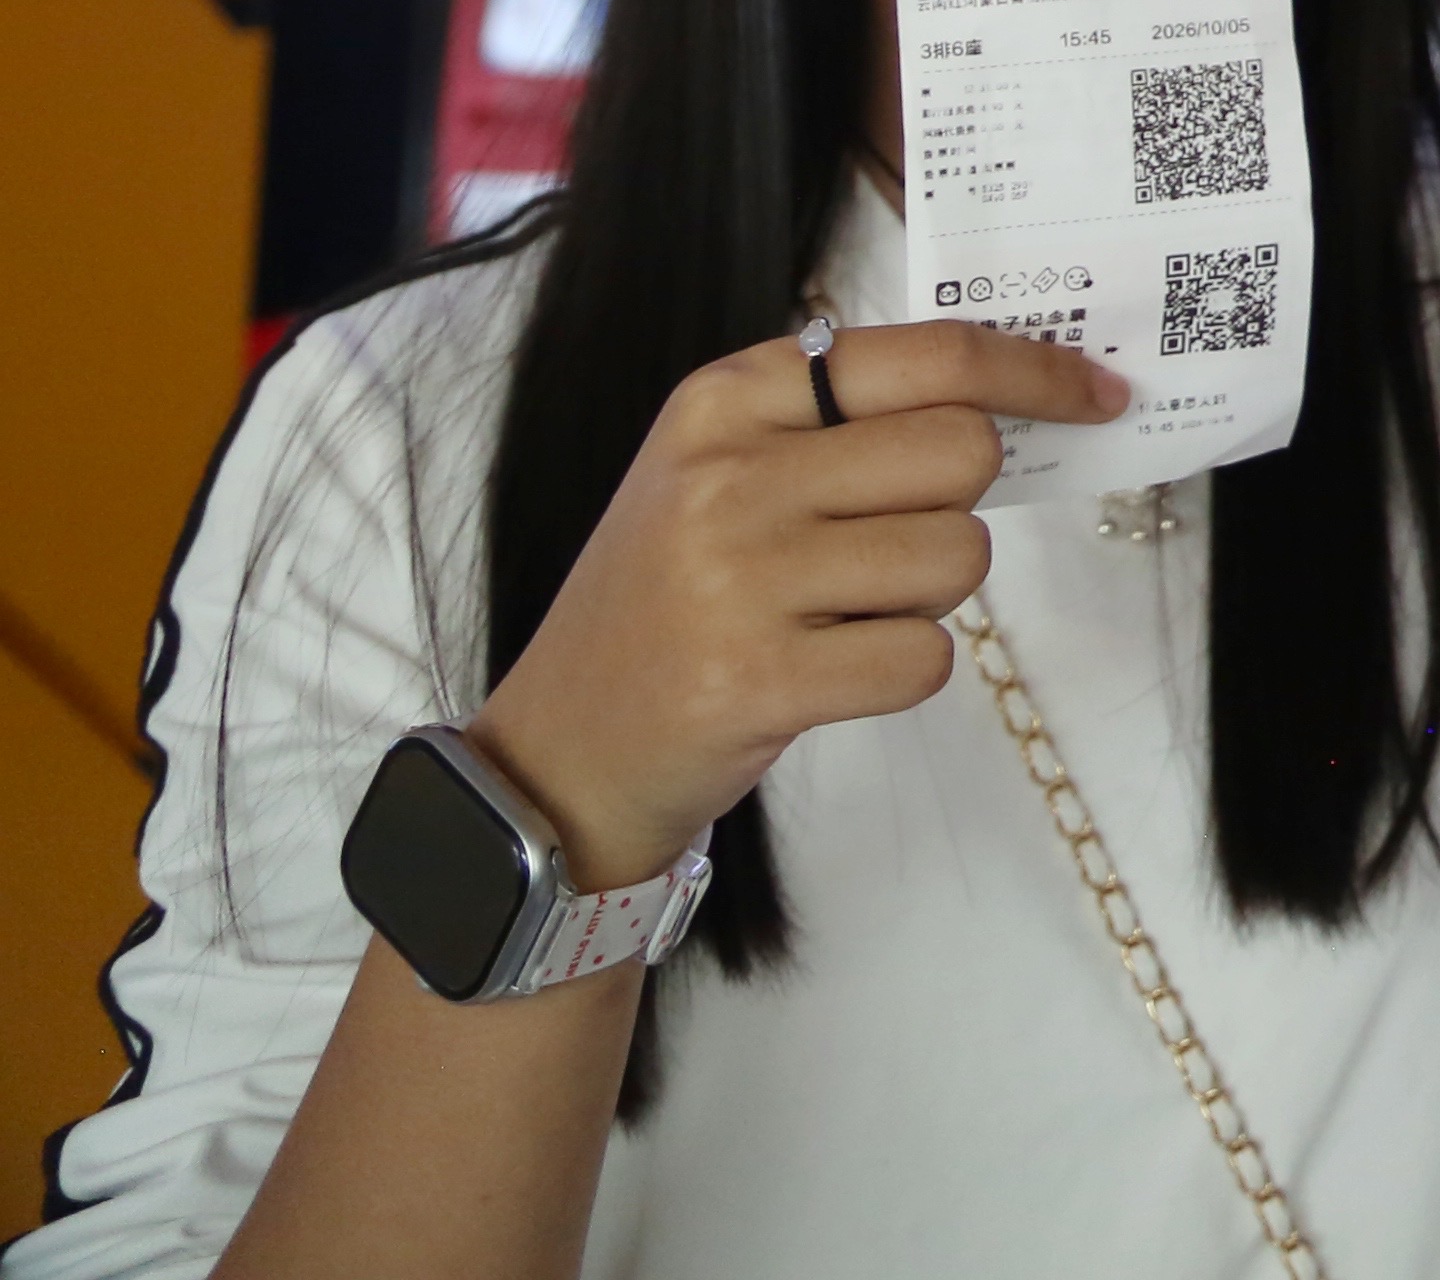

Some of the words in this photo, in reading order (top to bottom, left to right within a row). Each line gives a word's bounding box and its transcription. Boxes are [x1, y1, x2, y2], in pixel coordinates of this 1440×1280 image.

[920, 38, 983, 60] 3排6座
[1059, 29, 1112, 48] 15:45
[1151, 17, 1251, 41] 2026/10/05
